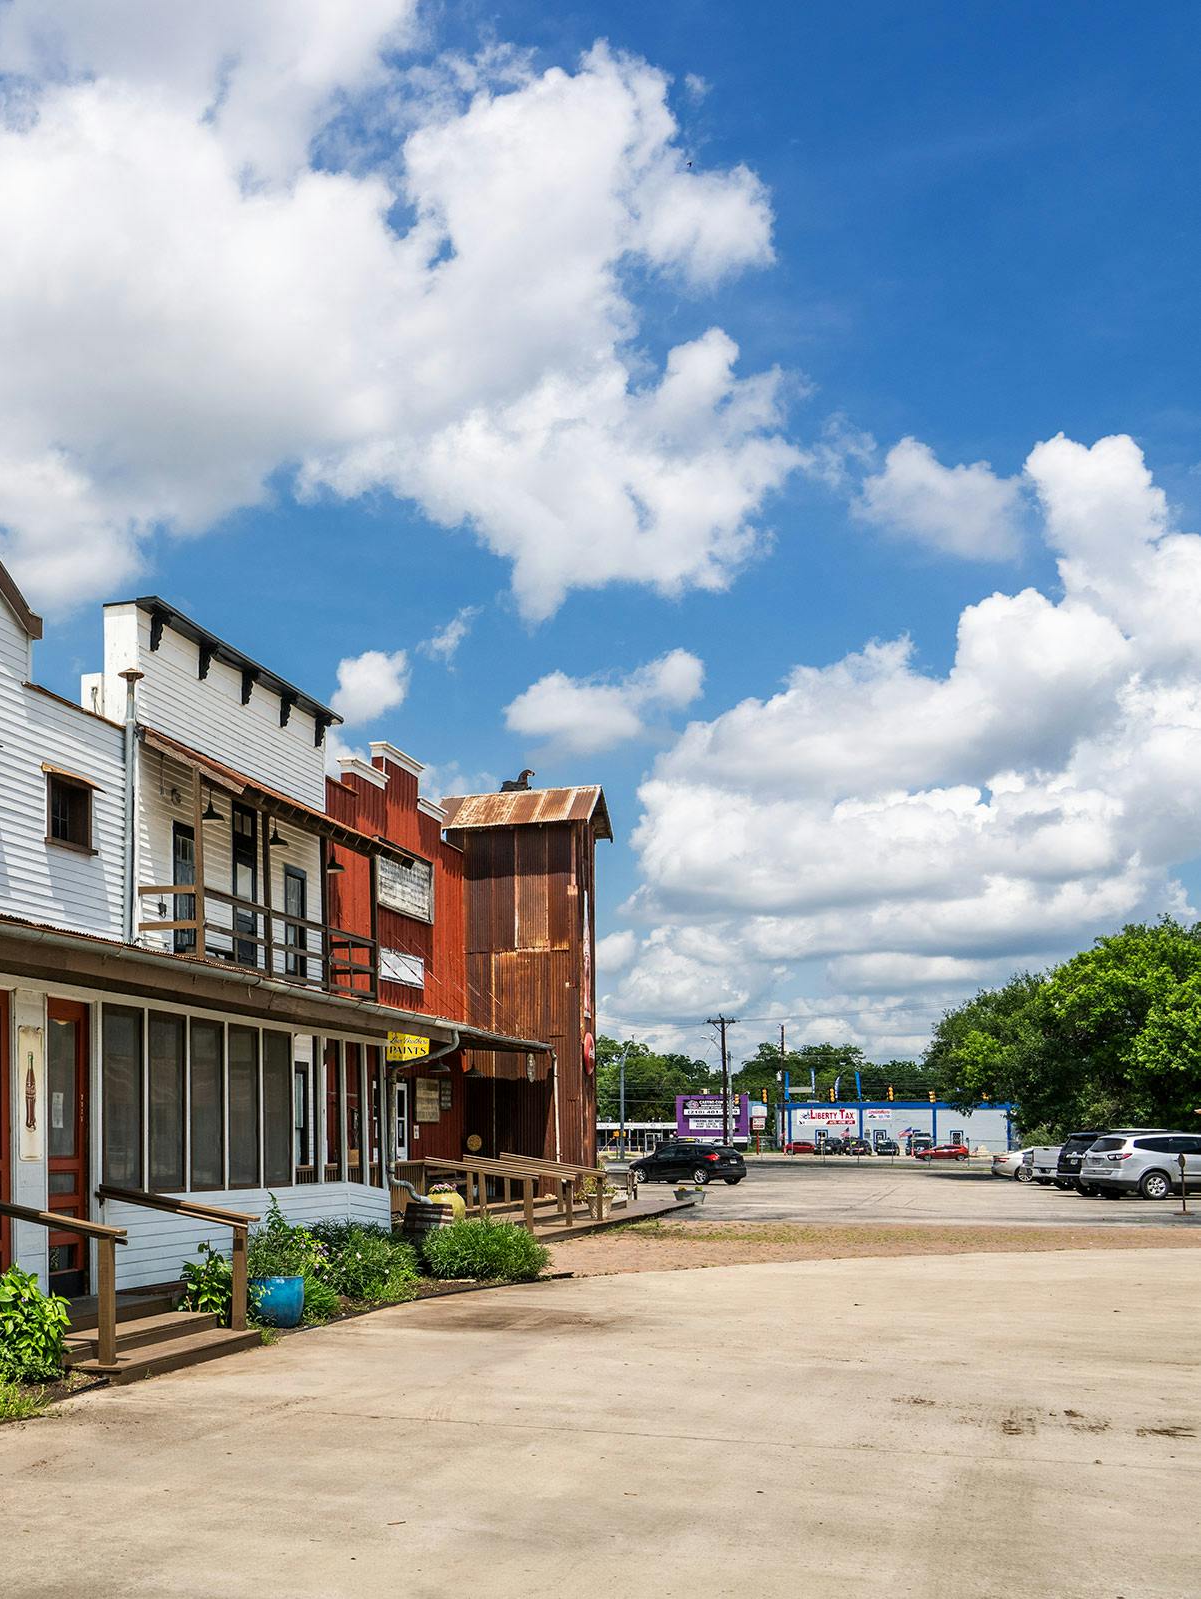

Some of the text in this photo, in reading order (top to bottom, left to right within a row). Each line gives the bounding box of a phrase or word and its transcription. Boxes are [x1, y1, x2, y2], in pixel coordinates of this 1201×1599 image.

[389, 1045, 427, 1056] PAINTS
[810, 1109, 838, 1120] LIBERTY
[838, 1108, 855, 1120] TAX
